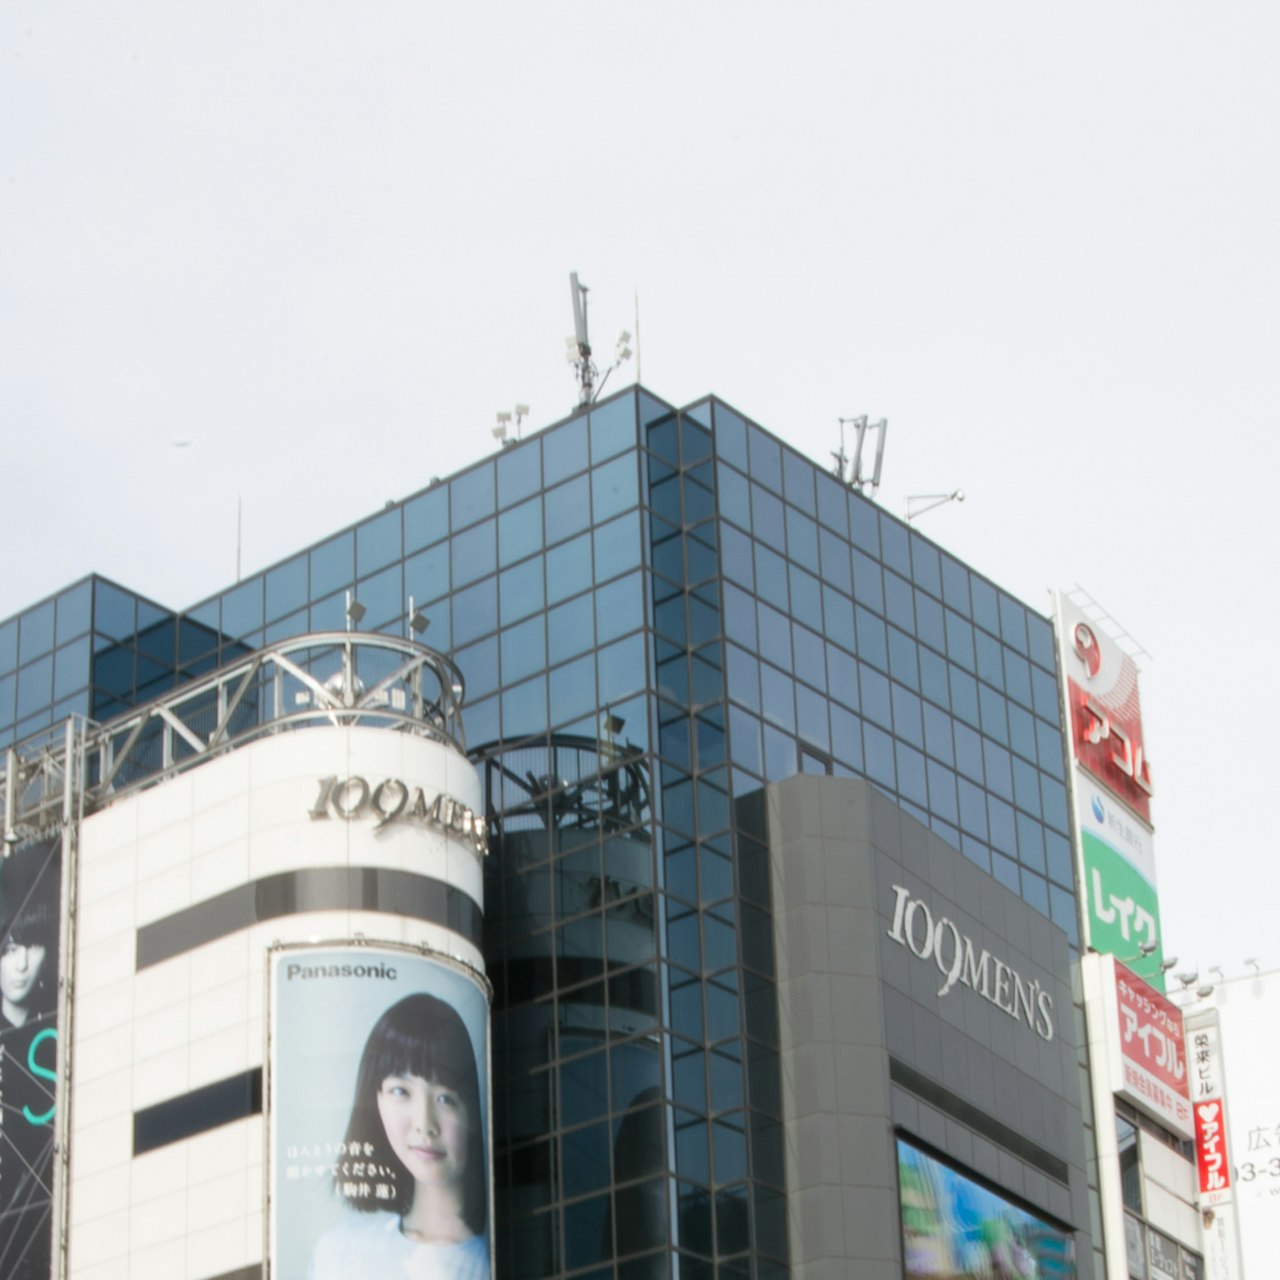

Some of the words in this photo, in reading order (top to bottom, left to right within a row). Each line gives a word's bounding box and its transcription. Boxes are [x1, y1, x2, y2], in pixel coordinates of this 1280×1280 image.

[1083, 695, 1150, 788] アコム
[1108, 811, 1142, 857] 新生銀行
[1092, 867, 1155, 948] レイク
[287, 963, 398, 981] Panasonic
[1118, 979, 1180, 1038] キャッシングなら
[1120, 1003, 1184, 1081] アイフル
[1202, 1122, 1226, 1191] アイフル
